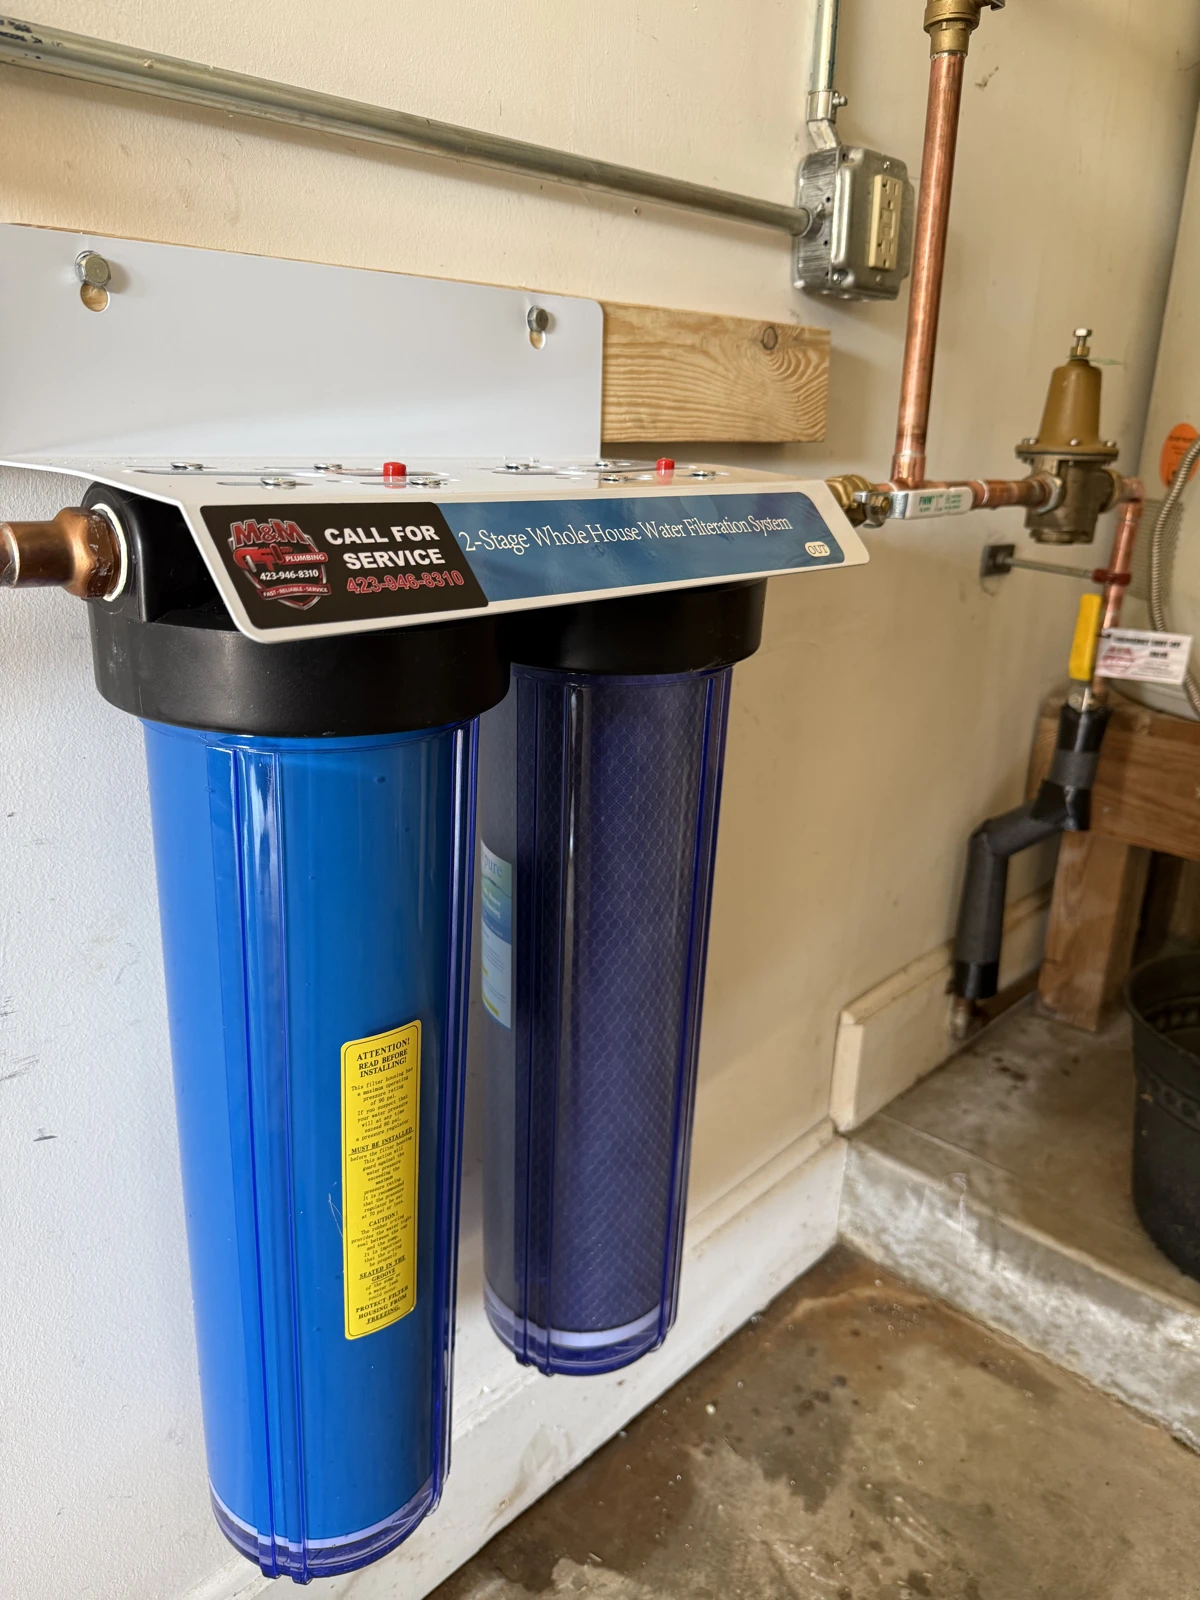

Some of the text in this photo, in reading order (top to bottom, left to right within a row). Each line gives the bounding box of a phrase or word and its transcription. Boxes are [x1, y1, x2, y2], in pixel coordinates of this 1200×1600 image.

[230, 519, 310, 547] M&M
[324, 525, 440, 545] CALL FOR
[458, 515, 793, 556] 2-Stage Whole House Water Filteration System
[807, 544, 830, 555] OUT
[285, 554, 325, 562] PLUMBING
[343, 548, 446, 570] SERVICE
[260, 569, 319, 581] 423-946-8310
[346, 570, 465, 595] 423-946-8310
[357, 1038, 410, 1061] ATTENTION!
[359, 1049, 407, 1070] READ BEFORE
[360, 1057, 406, 1077] INSTALLING!
[366, 1080, 383, 1088] filter
[386, 1072, 404, 1080] housing
[386, 1076, 408, 1088] operating
[363, 1085, 403, 1102] pressure rating
[378, 1099, 396, 1110] suspect
[388, 1101, 408, 1113] pressure
[362, 1130, 384, 1141] pressure
[387, 1119, 409, 1132] regulator
[365, 1124, 382, 1133] exceed
[351, 1145, 369, 1154] MUST
[377, 1152, 392, 1161] action
[369, 1211, 398, 1227] CAUTION!
[360, 1266, 384, 1278] SEATED
[372, 1268, 395, 1281] GROOVE
[356, 1285, 408, 1313] PROTECT FILTER
[358, 1293, 407, 1319] HOUSING FROM
